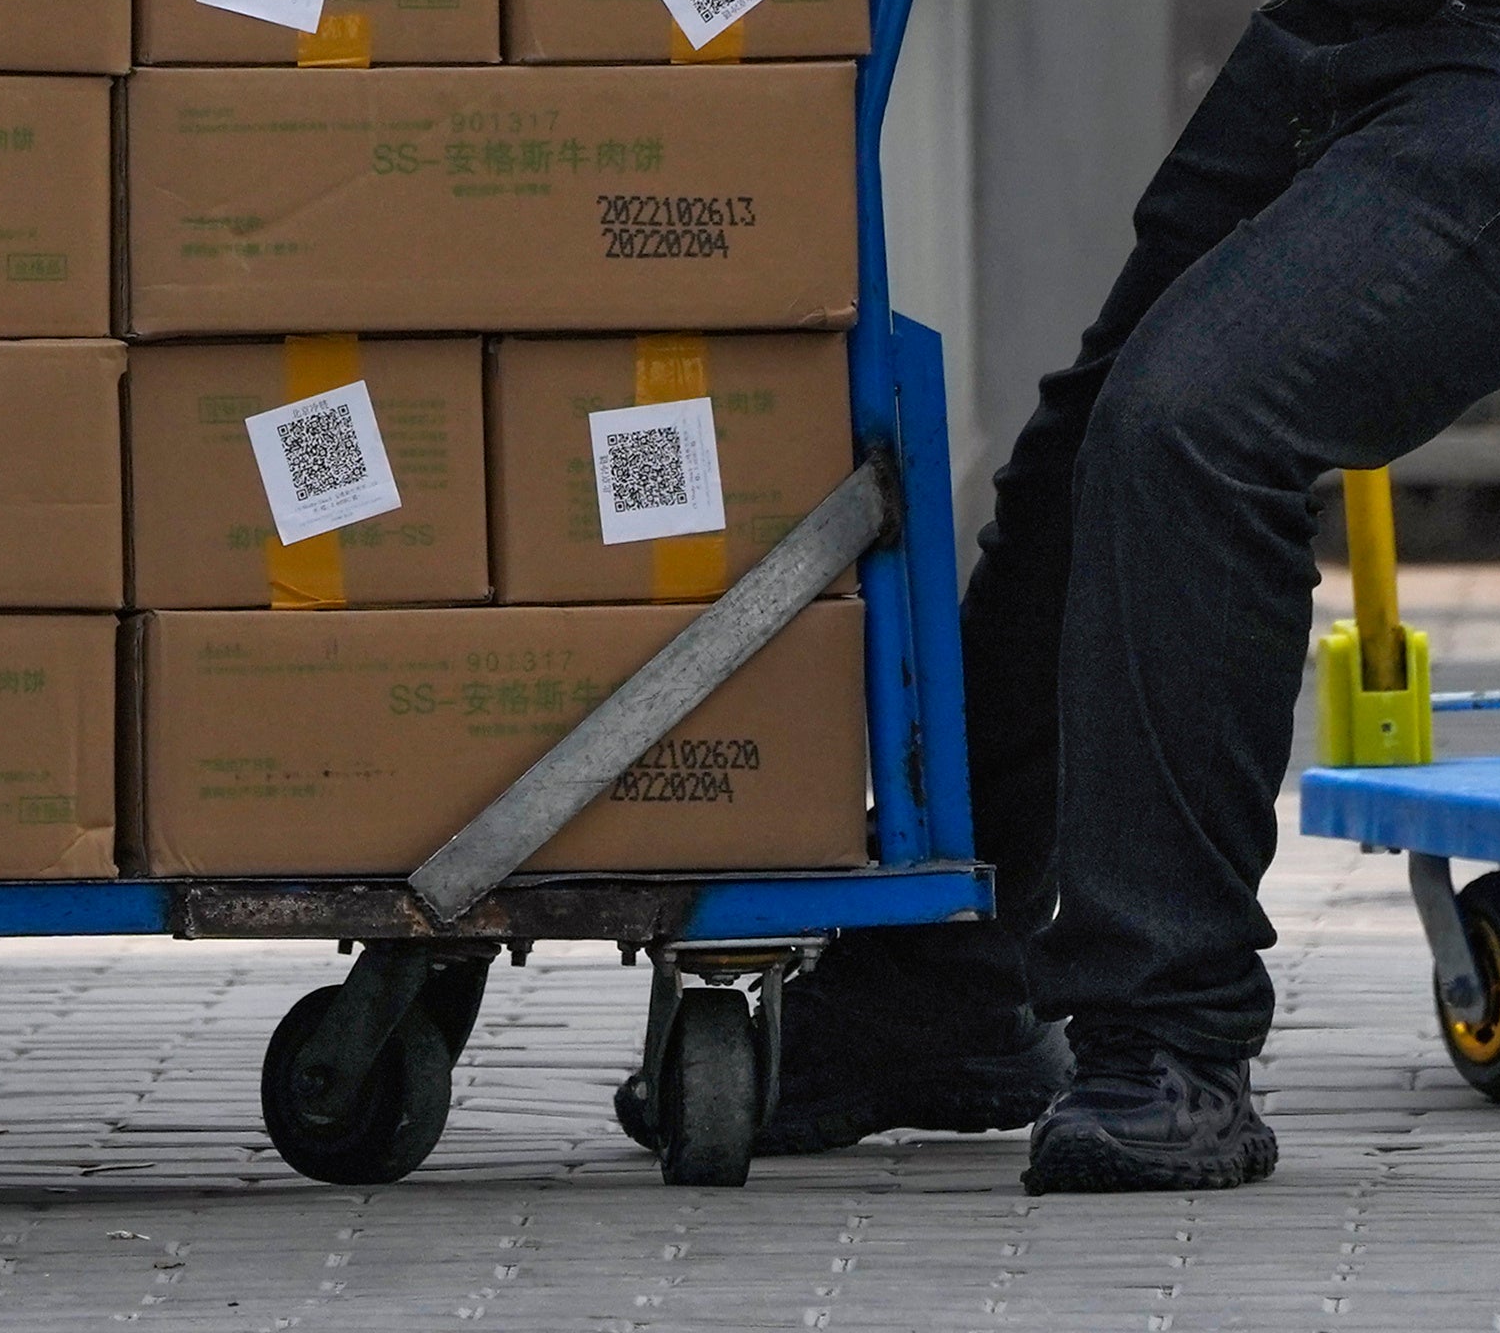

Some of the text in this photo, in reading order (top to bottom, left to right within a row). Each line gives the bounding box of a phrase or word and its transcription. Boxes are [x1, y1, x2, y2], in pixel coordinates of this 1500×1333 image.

[450, 109, 561, 135] 901317
[371, 137, 666, 177] SS-安格斯牛肉饼
[596, 195, 758, 229] 2022102613
[603, 225, 730, 260] 20220204
[608, 770, 735, 805] 20220204
